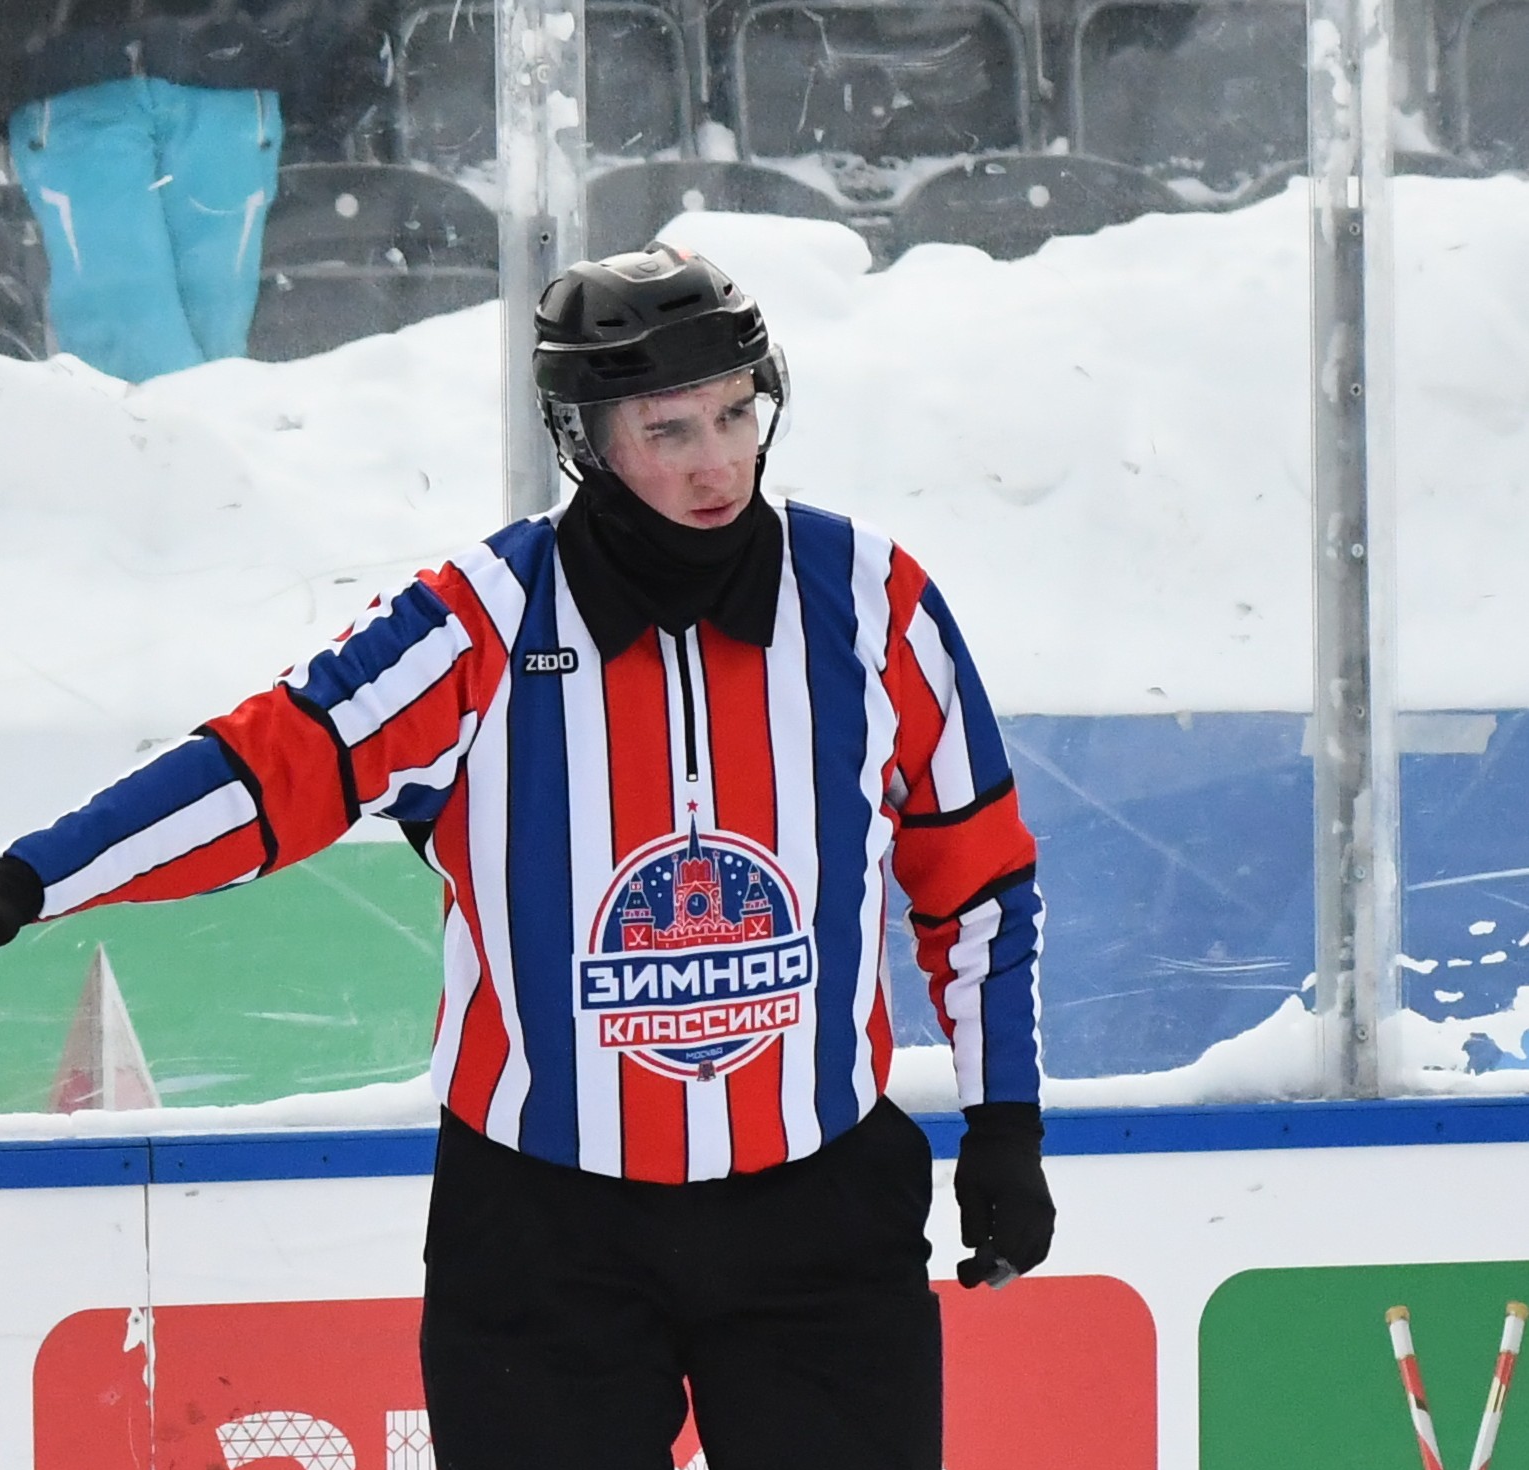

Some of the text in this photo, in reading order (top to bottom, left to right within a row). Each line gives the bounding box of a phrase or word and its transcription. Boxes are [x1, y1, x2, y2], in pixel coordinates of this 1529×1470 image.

[525, 652, 574, 671] ZEDO
[587, 944, 808, 1003] ЗИМНЯЯ
[604, 997, 797, 1043] КЛАССИКА
[686, 1047, 724, 1061] МОСКВА
